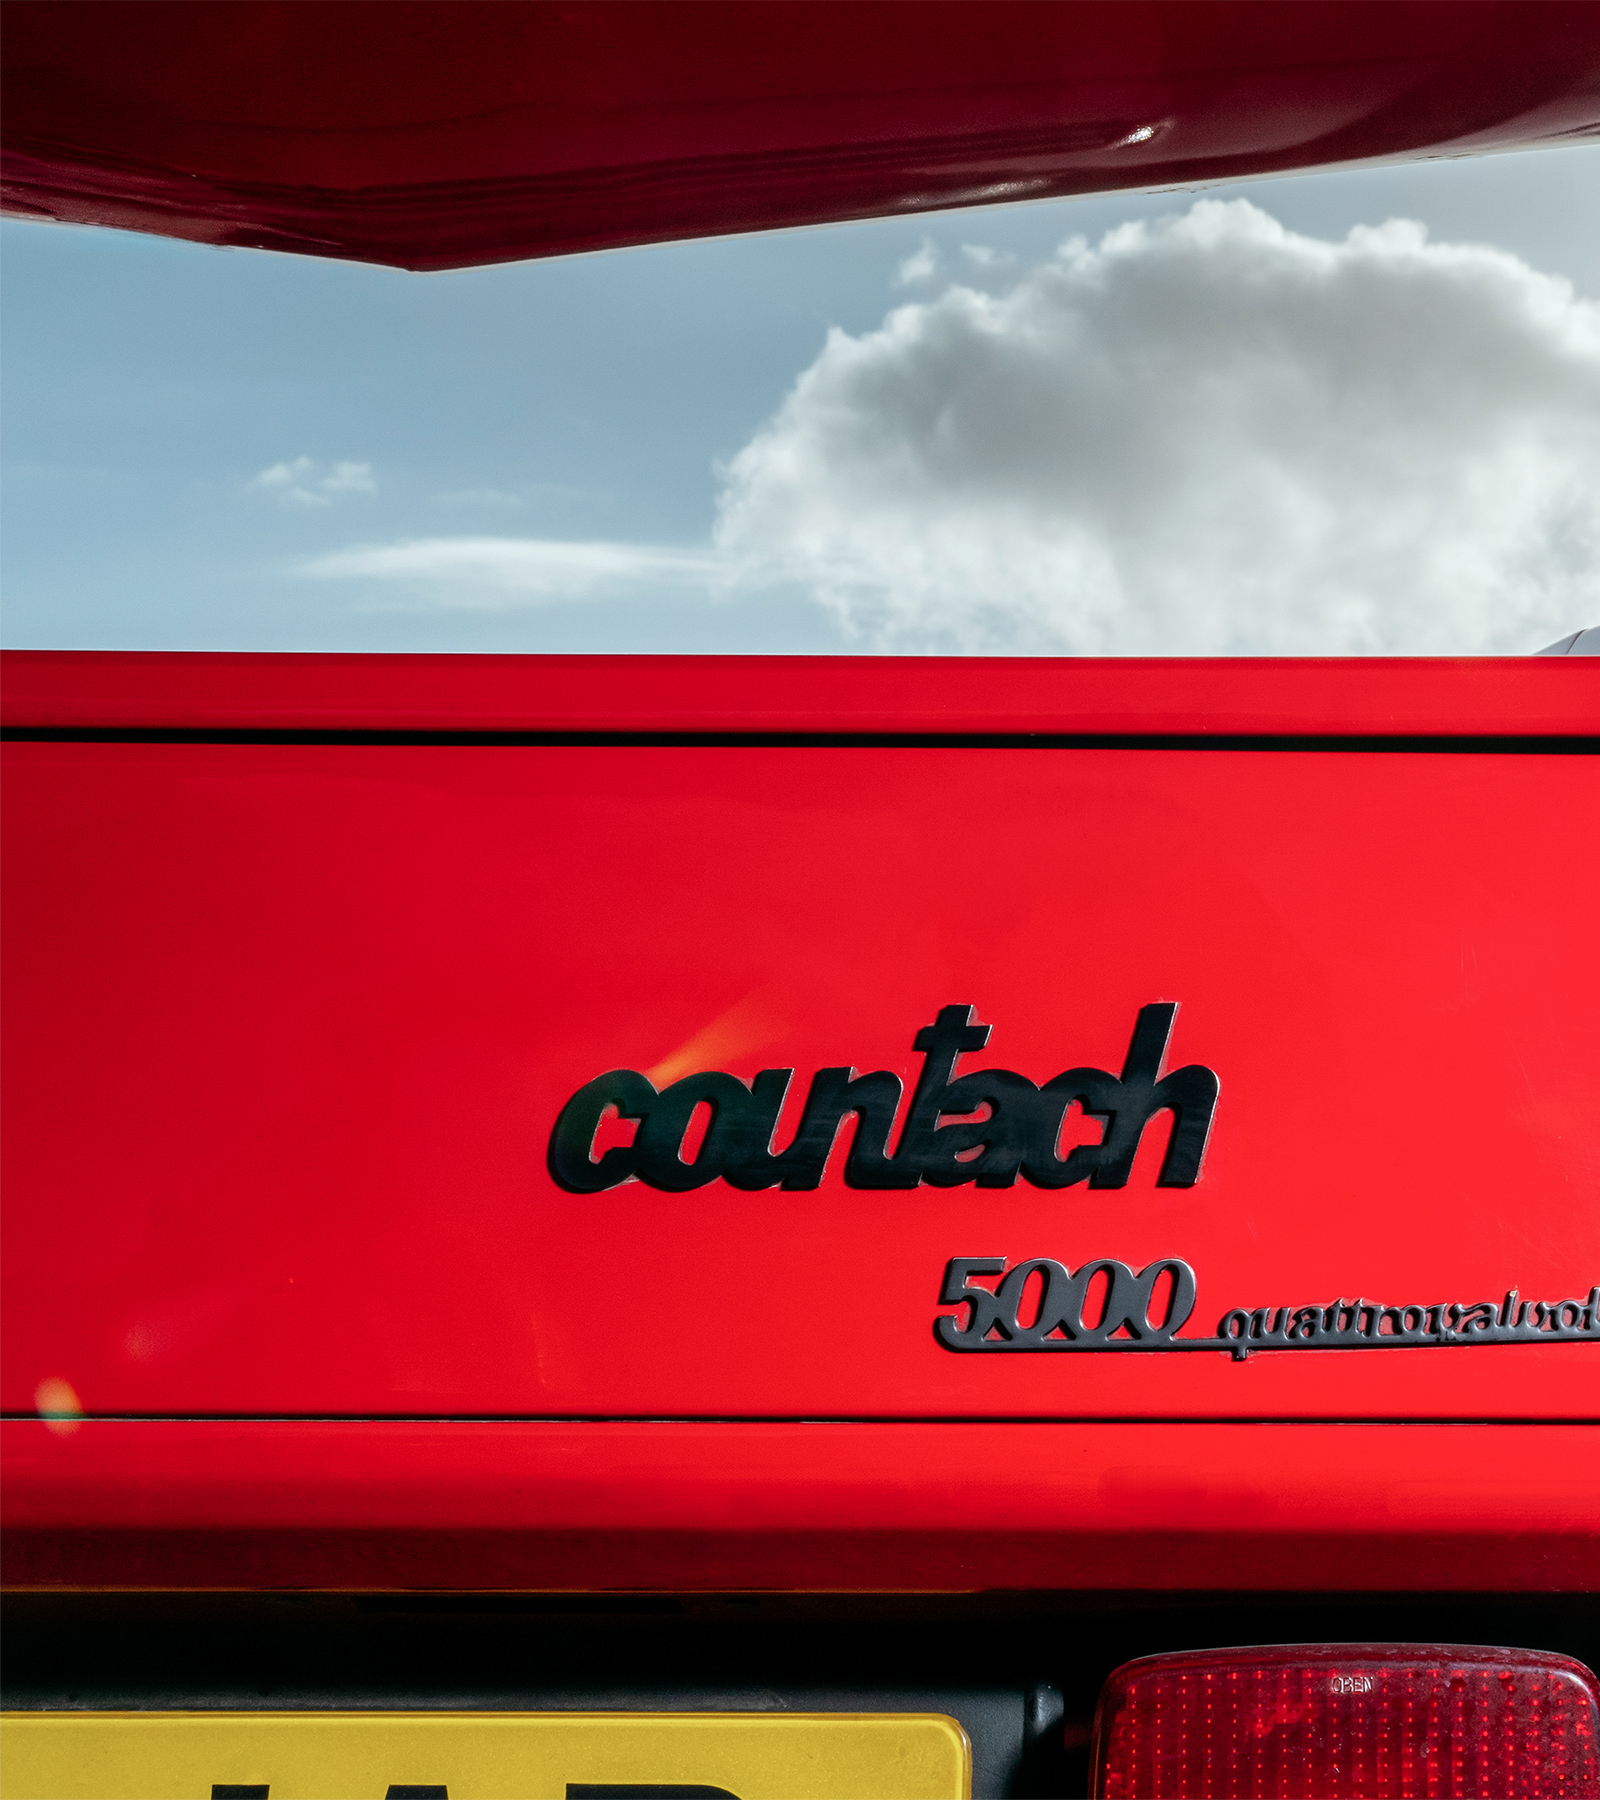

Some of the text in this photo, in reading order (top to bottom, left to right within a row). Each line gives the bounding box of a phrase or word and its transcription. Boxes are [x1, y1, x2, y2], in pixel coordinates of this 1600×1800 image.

[547, 1001, 1221, 1193] countach
[933, 1256, 1198, 1353] 5000
[1331, 1676, 1374, 1694] OBEN
